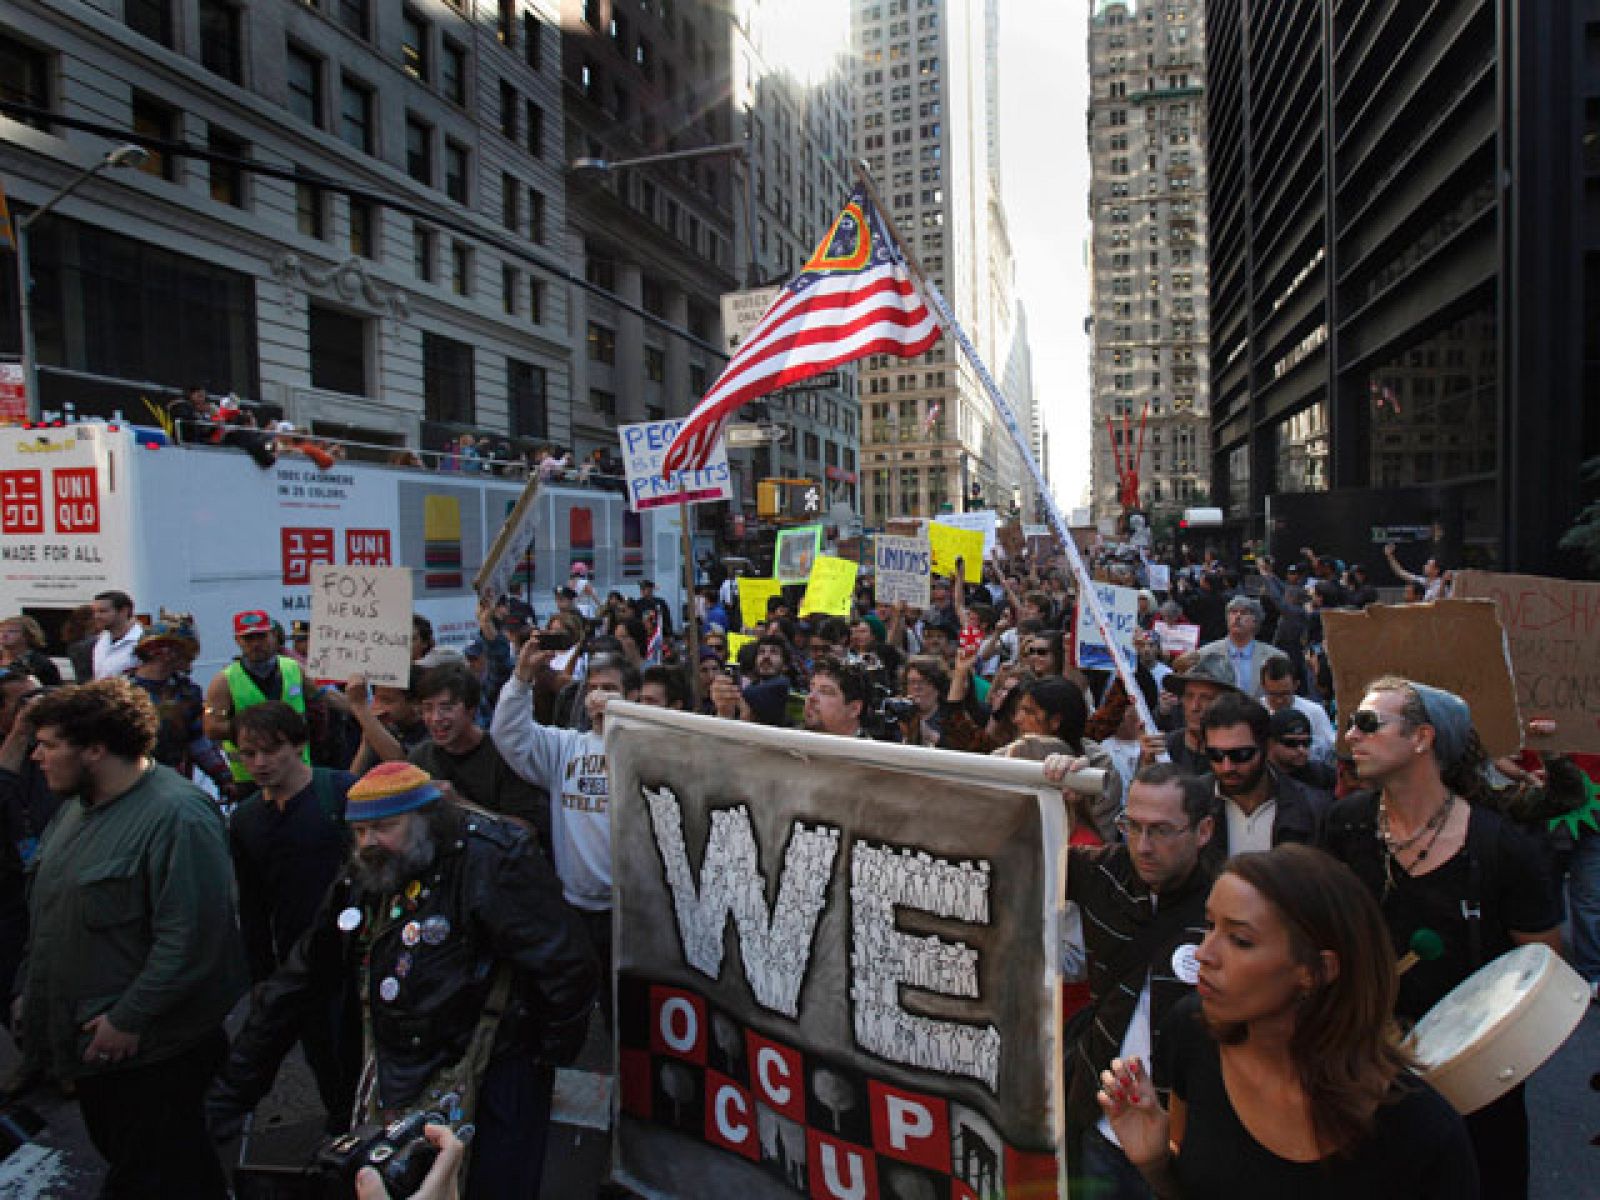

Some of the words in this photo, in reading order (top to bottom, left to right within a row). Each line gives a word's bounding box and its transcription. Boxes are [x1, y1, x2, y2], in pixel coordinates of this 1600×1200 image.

[57, 474, 90, 498] UNI
[60, 503, 95, 531] QLO
[2, 545, 37, 562] MADE
[43, 544, 70, 562] FOR
[74, 544, 103, 563] ALL
[350, 535, 384, 553] UNI
[878, 547, 929, 576] UNIONS
[320, 572, 376, 598] FOX
[327, 600, 380, 618] NEWS
[318, 624, 341, 641] TRY
[335, 646, 373, 663] THIS
[640, 783, 1000, 1095] WE
